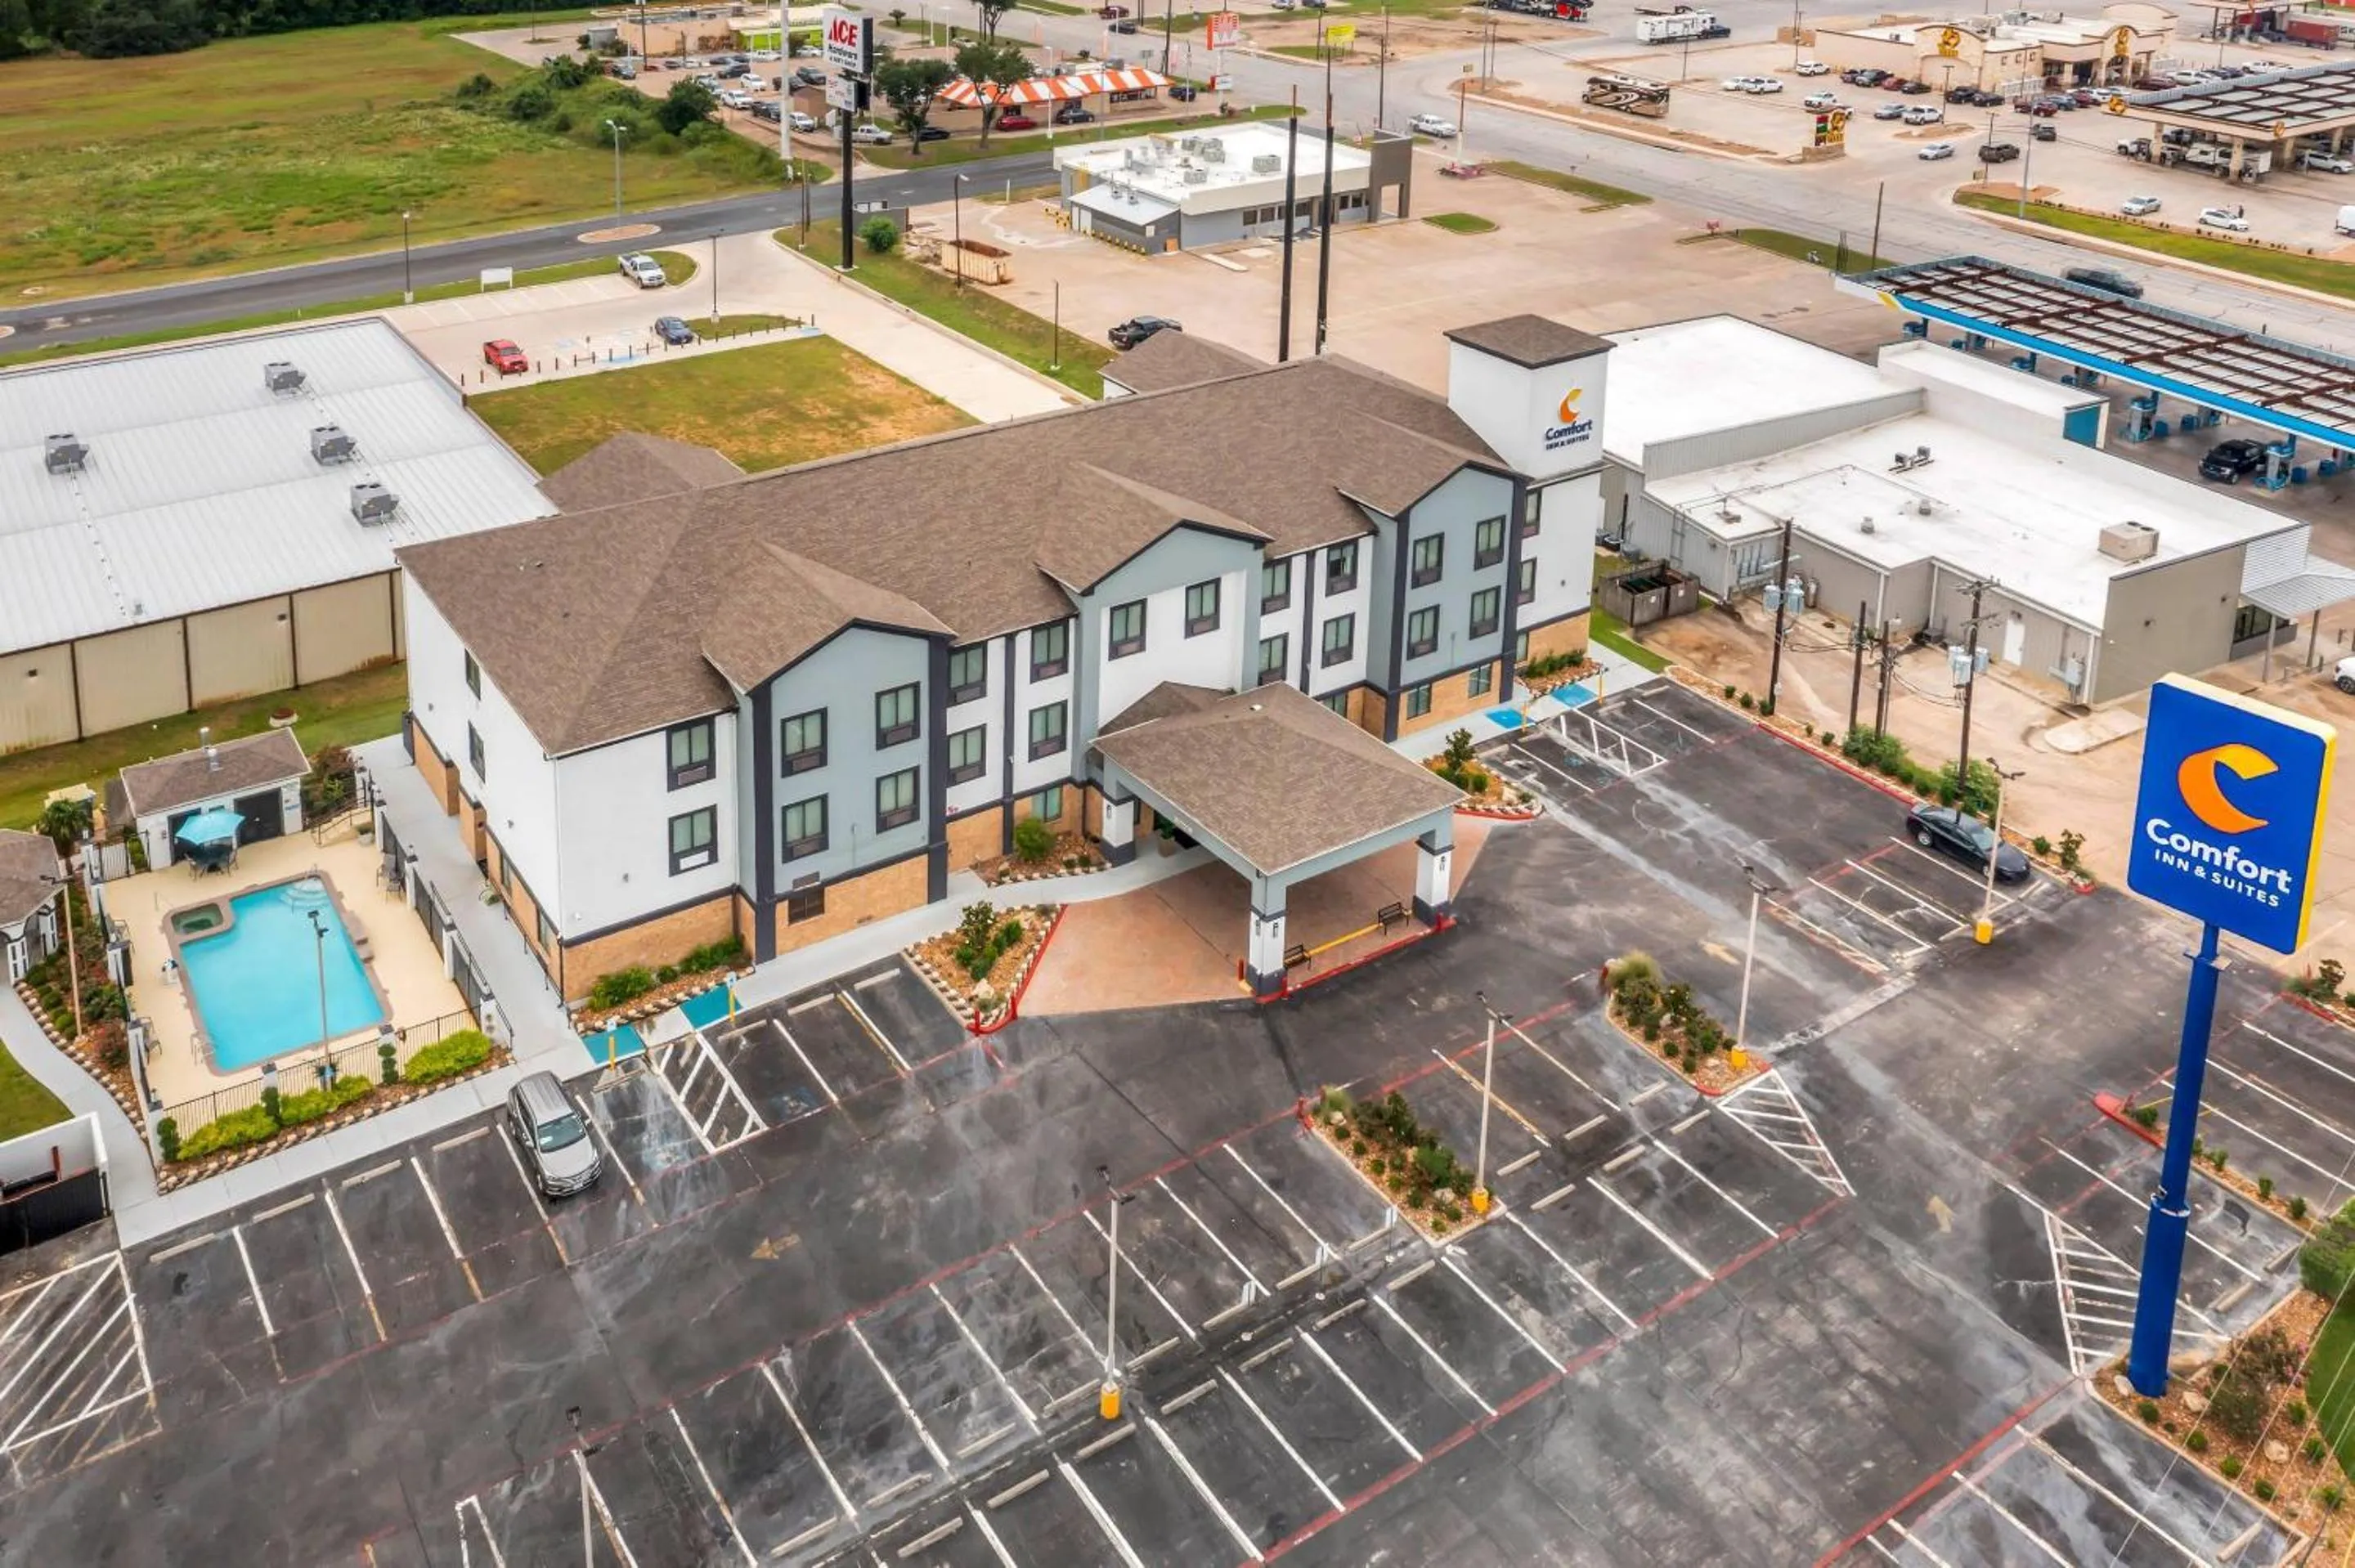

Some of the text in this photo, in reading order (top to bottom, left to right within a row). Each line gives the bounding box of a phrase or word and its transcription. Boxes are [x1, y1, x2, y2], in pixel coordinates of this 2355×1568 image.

[828, 16, 858, 47] ACE
[1545, 419, 1593, 441] Comfort
[2146, 818, 2292, 894] Comfort
[2155, 849, 2280, 907] INN & SUITES
